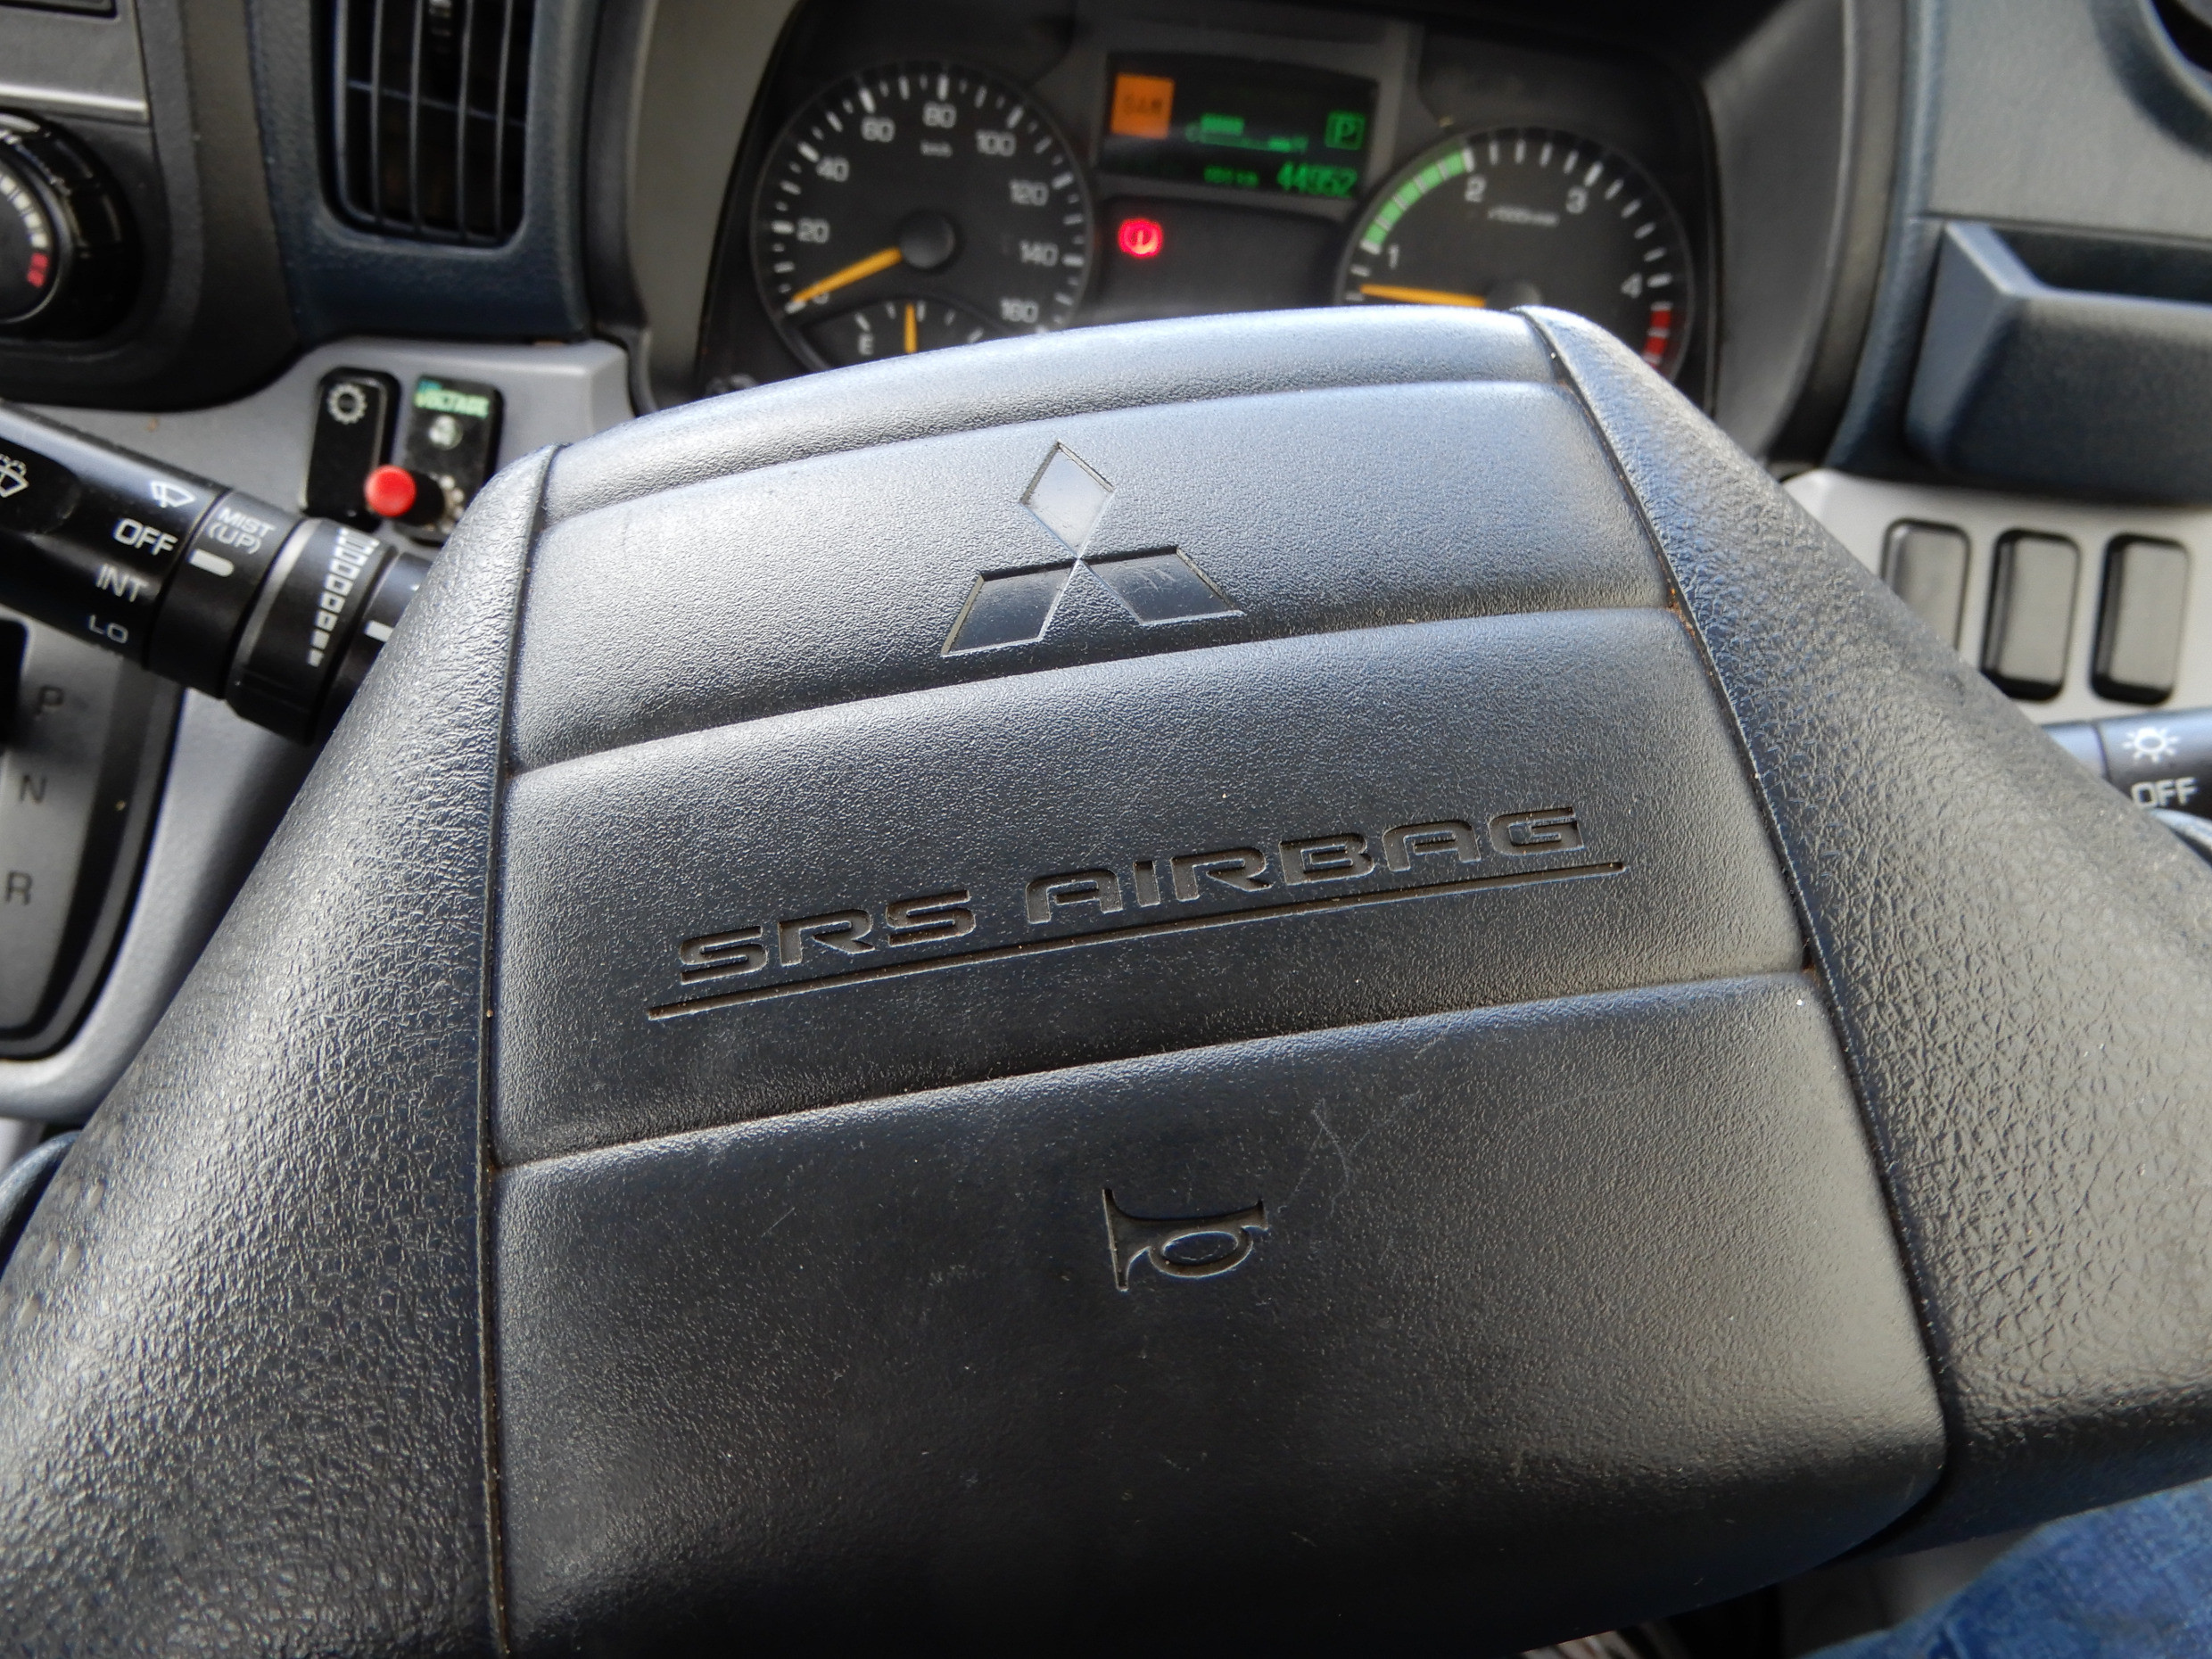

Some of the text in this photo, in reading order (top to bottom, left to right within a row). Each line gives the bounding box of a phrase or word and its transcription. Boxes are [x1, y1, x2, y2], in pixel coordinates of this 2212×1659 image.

[1465, 176, 1488, 203] 2
[1566, 186, 1589, 215] 3
[1388, 243, 1399, 269] 1
[1621, 272, 1643, 299] 4
[113, 518, 177, 556] OFF
[209, 522, 261, 555] (UP)
[219, 506, 277, 539] MIST
[95, 564, 149, 602] INT
[89, 614, 128, 644] LO
[34, 684, 64, 721] P
[20, 773, 46, 804] N
[2131, 776, 2198, 809] OFF
[4, 869, 33, 906] R
[679, 805, 1586, 986] SRS AIRBAG
